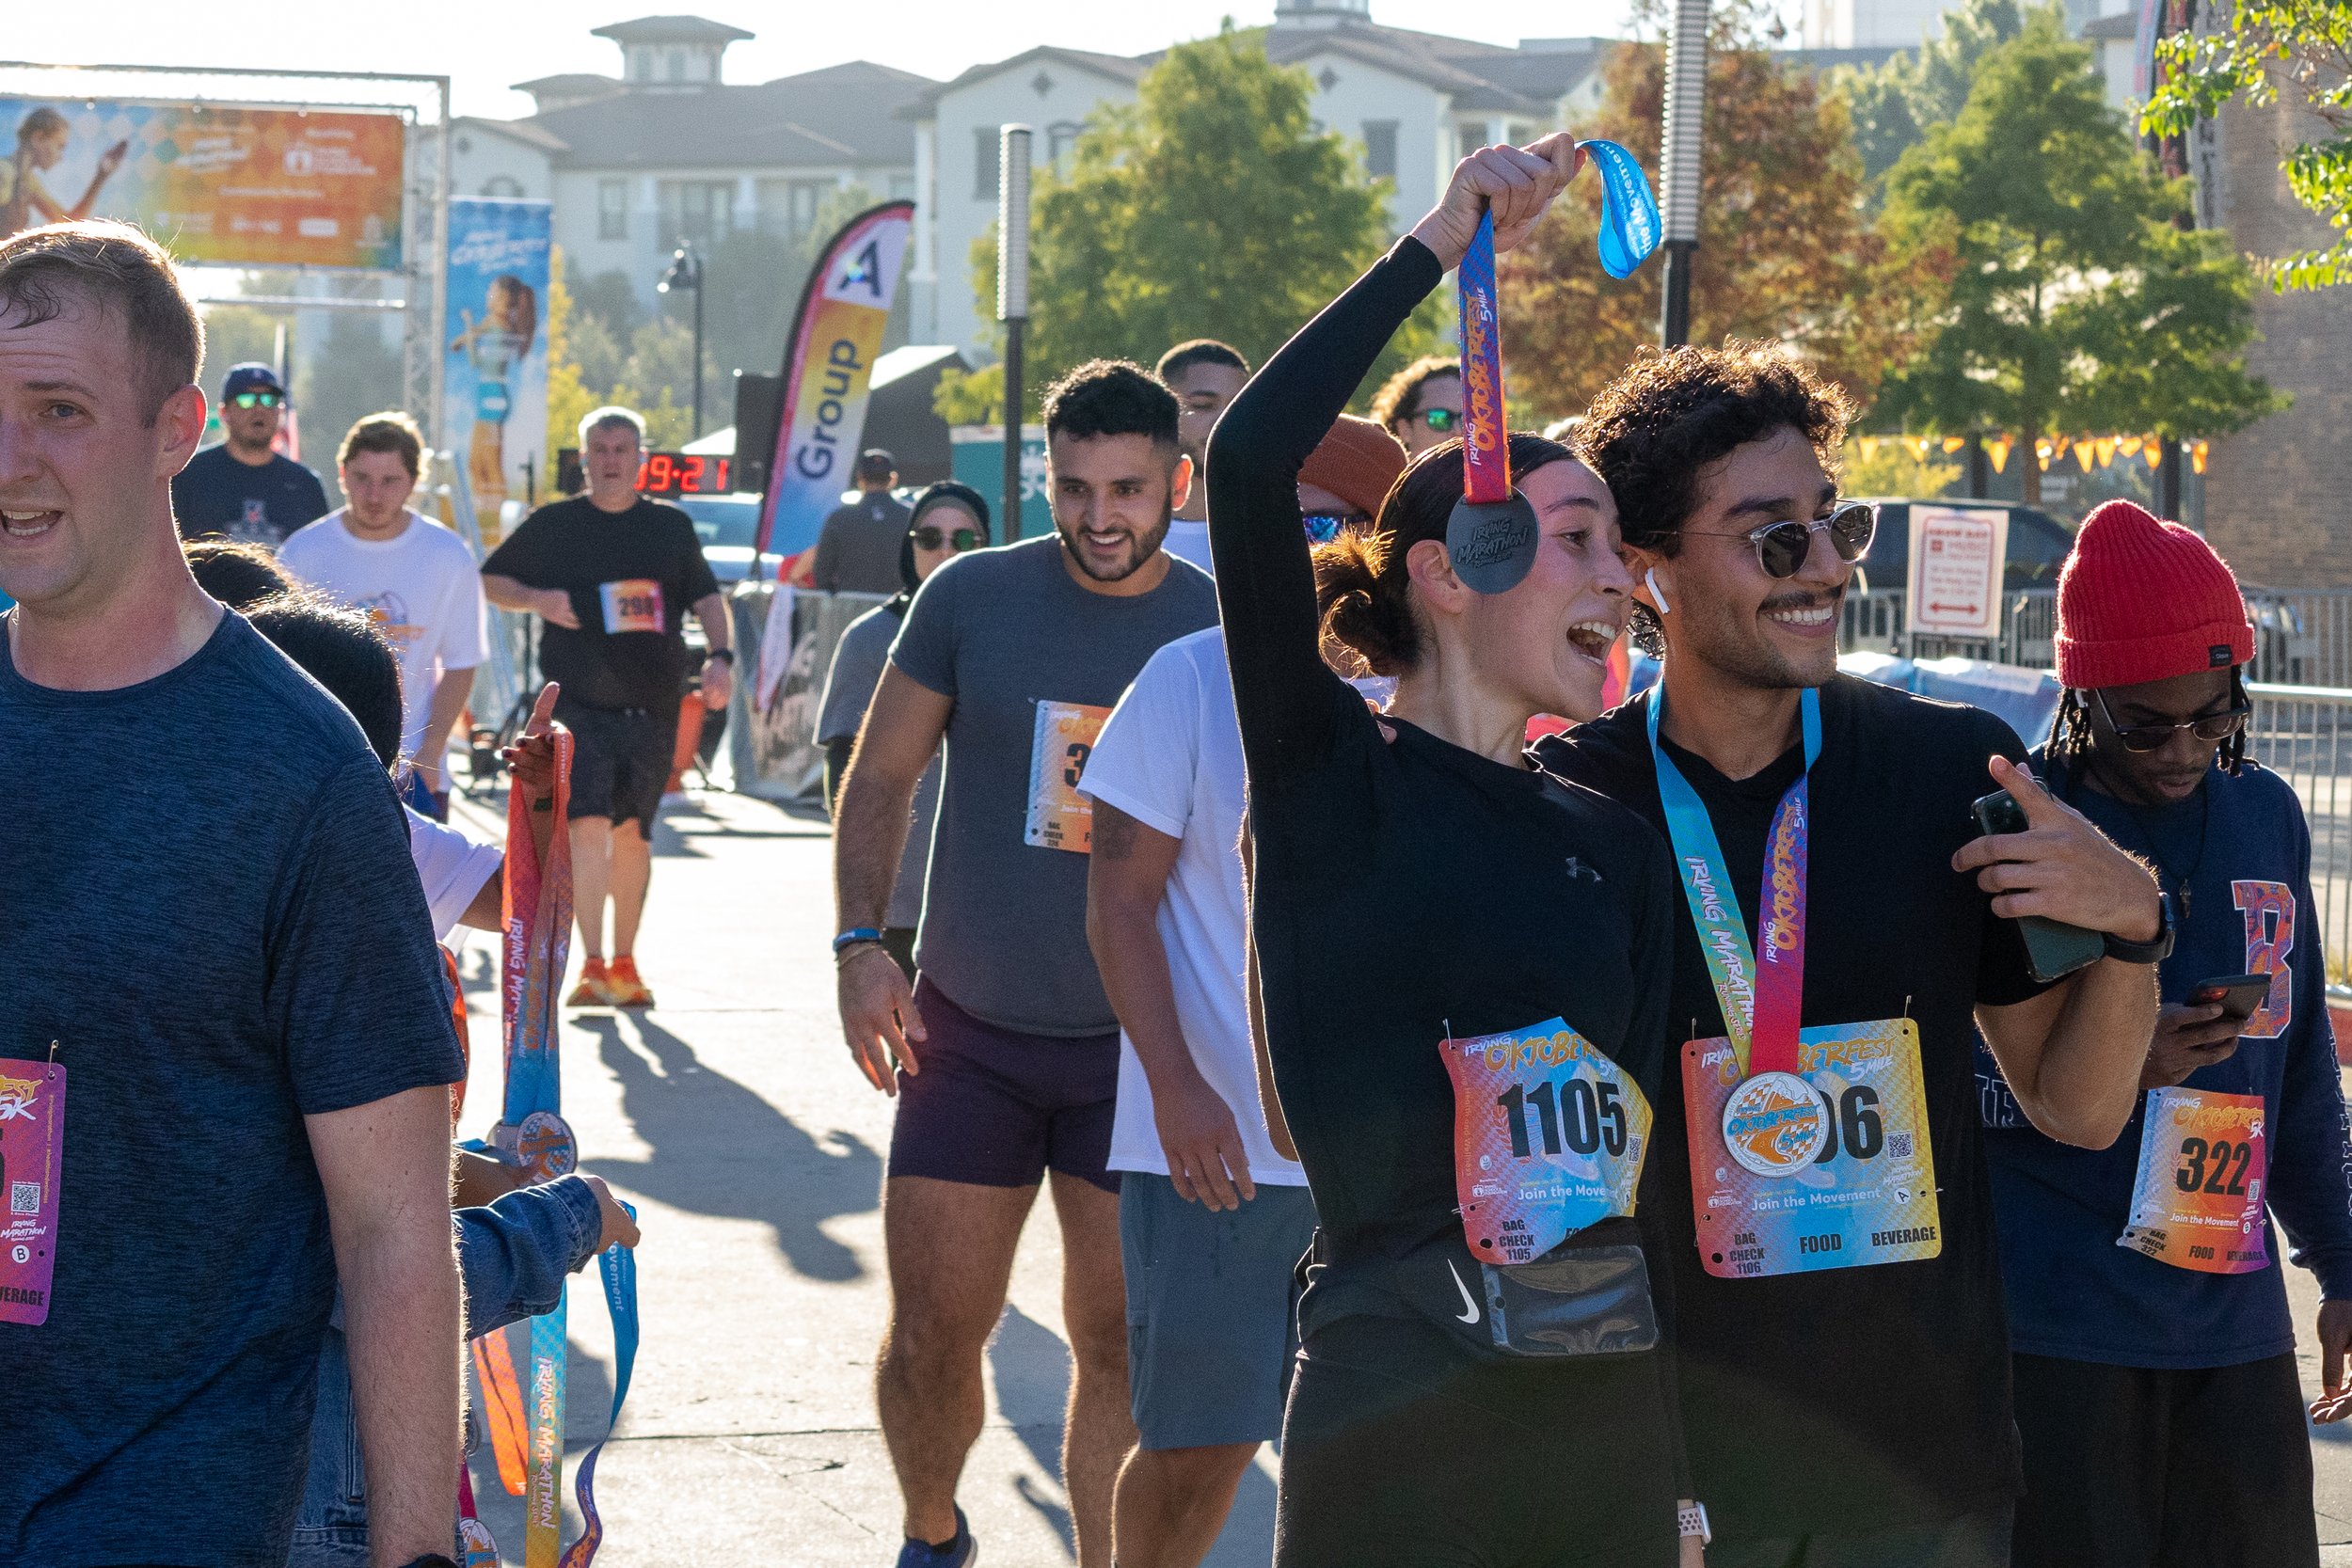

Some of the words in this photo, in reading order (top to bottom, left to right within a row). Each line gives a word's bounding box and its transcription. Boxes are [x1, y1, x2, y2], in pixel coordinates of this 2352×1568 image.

[1599, 142, 1647, 226] Movement
[1477, 287, 1488, 310] MILE
[1480, 309, 1493, 323] 5
[1465, 290, 1496, 452] OKTOBERFEST
[795, 339, 864, 481] Group
[1465, 422, 1483, 467] IRVING
[1472, 516, 1512, 542] IRVING
[1455, 526, 1530, 565] MARATHON
[1793, 797, 1804, 817] MILE
[1793, 816, 1805, 829] 5
[1772, 801, 1801, 951] OKTOBERFEST
[1685, 856, 1728, 923] IRVING
[509, 917, 526, 970] IRVING
[1763, 919, 1779, 964] IRVING
[1464, 1034, 1513, 1057] IRVING
[1849, 1061, 1866, 1082] 5
[1866, 1054, 1894, 1072] MILE
[2164, 1097, 2202, 1108] IRVING
[1497, 1078, 1626, 1159] 1105
[1726, 1103, 1820, 1137] OKTOBERFEST
[1780, 1132, 1794, 1150] 5
[2176, 1136, 2252, 1196] 322
[1517, 1187, 1548, 1201] Join
[1550, 1184, 1572, 1198] the
[1751, 1198, 1780, 1212] Join
[1784, 1195, 1806, 1208] the
[1809, 1188, 1882, 1205] Movement
[1897, 1191, 1910, 1203] A
[11, 1219, 37, 1228] IRVING
[1502, 1219, 1526, 1232] BAG
[2169, 1212, 2188, 1223] Join
[2189, 1215, 2203, 1225] the
[2204, 1216, 2240, 1227] Movement
[0, 1226, 47, 1239] MARATHON
[1498, 1234, 1535, 1247] CHECK
[1734, 1231, 1756, 1245] BAG
[1871, 1226, 1937, 1246] BEVERAGE
[2149, 1229, 2168, 1240] BAG
[16, 1247, 26, 1260] B
[1799, 1233, 1842, 1255] FOOD
[2139, 1236, 2168, 1252] CHECK
[2140, 1243, 2158, 1257] 322
[2188, 1245, 2215, 1260] FOOD
[1506, 1248, 1532, 1261] 1105
[1729, 1247, 1766, 1262] CHECK
[1736, 1260, 1761, 1275] 1106
[536, 1356, 556, 1419] IRVING
[535, 1426, 557, 1529] MARATHON
